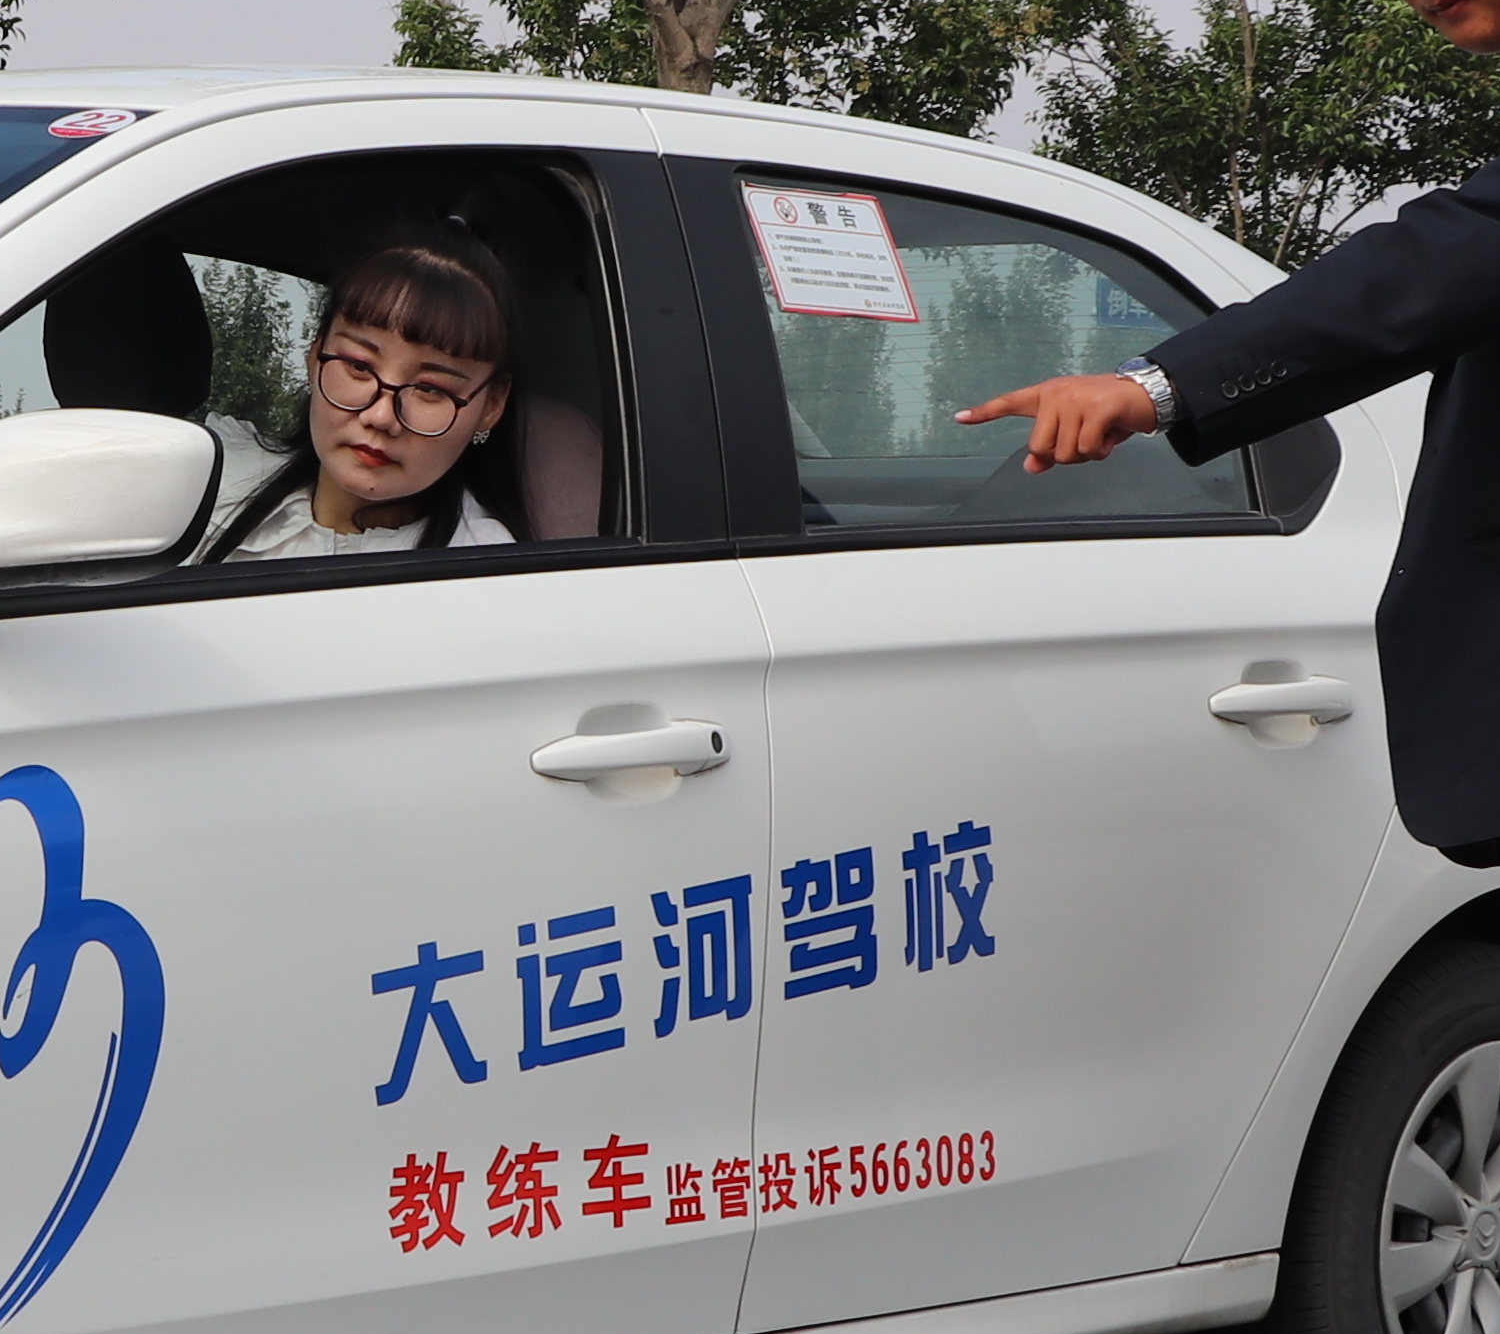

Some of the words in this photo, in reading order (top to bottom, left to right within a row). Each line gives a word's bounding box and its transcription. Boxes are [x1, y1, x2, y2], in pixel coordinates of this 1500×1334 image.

[63, 113, 128, 130] 22
[805, 201, 858, 230] 警告
[370, 819, 997, 1107] 大运河驾校
